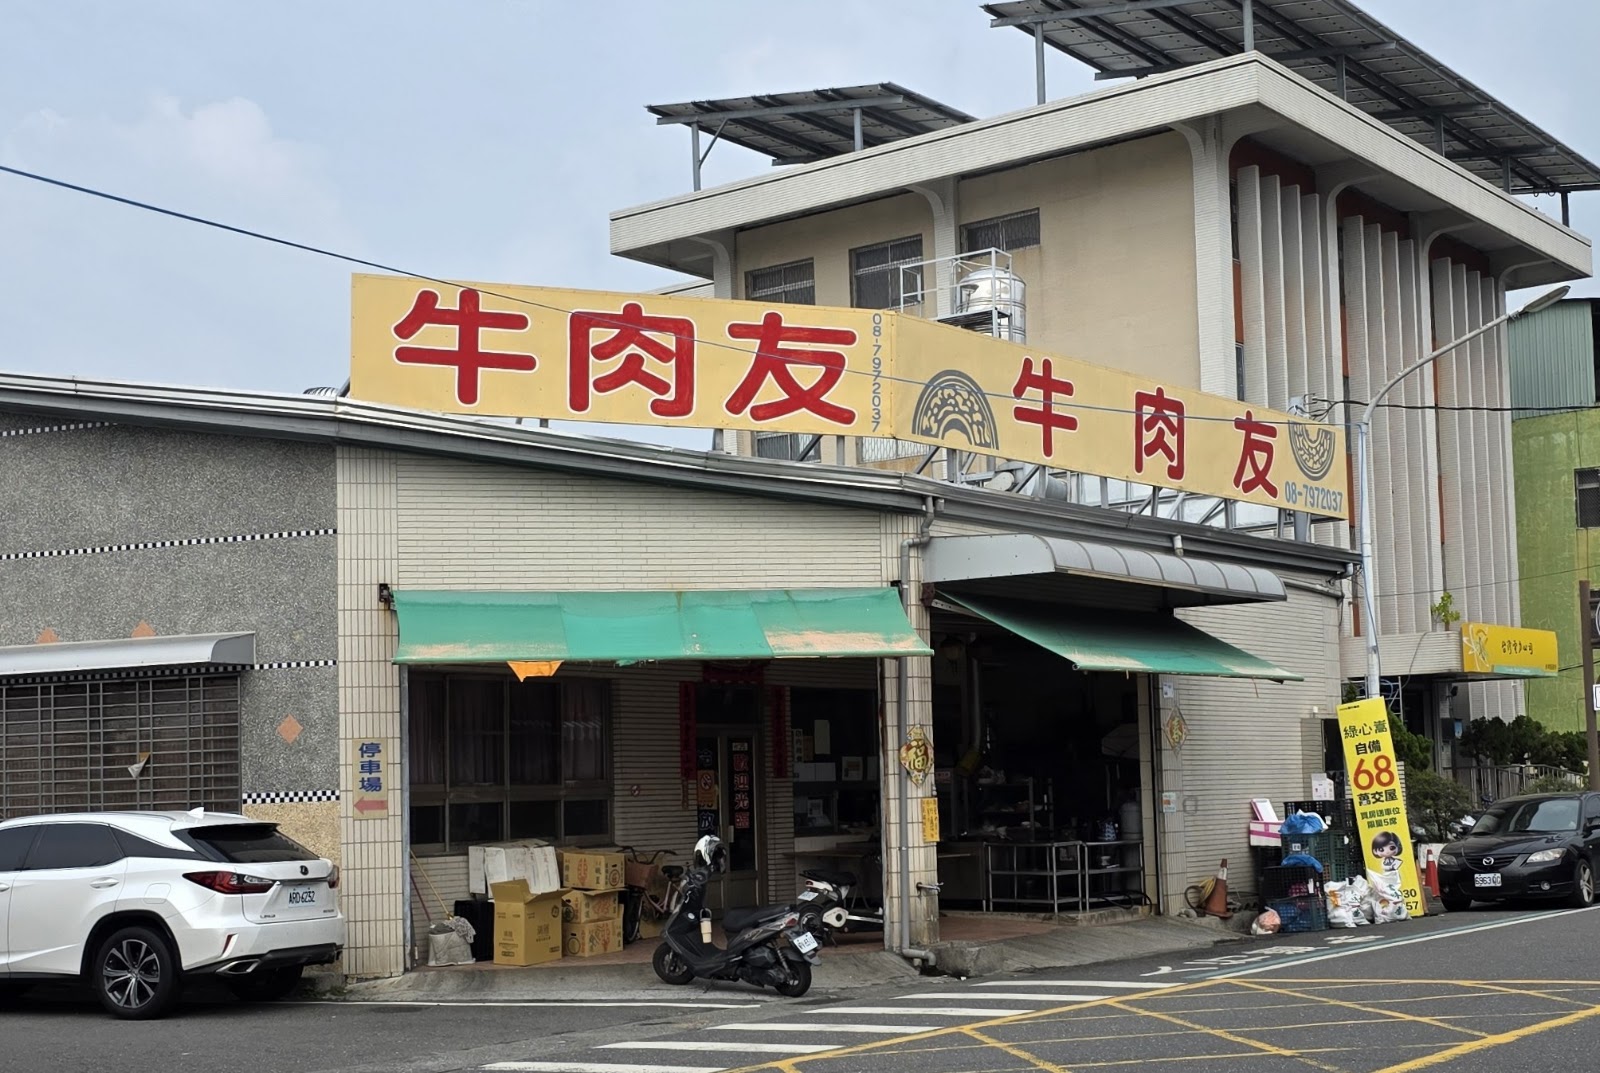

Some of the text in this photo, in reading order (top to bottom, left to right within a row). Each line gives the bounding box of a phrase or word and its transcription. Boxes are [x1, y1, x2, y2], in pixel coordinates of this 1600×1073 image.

[393, 289, 858, 425] 牛肉友
[872, 313, 882, 432] 08-7972037
[1012, 357, 1279, 499] 牛肉友
[1285, 481, 1343, 512] 08-7972037
[358, 742, 382, 792] 停車場
[1355, 740, 1381, 755] 自備
[733, 753, 750, 829] 歡迎光臨
[1353, 755, 1395, 790] 68
[1357, 789, 1398, 806] 萬交屋
[1404, 901, 1419, 910] 57
